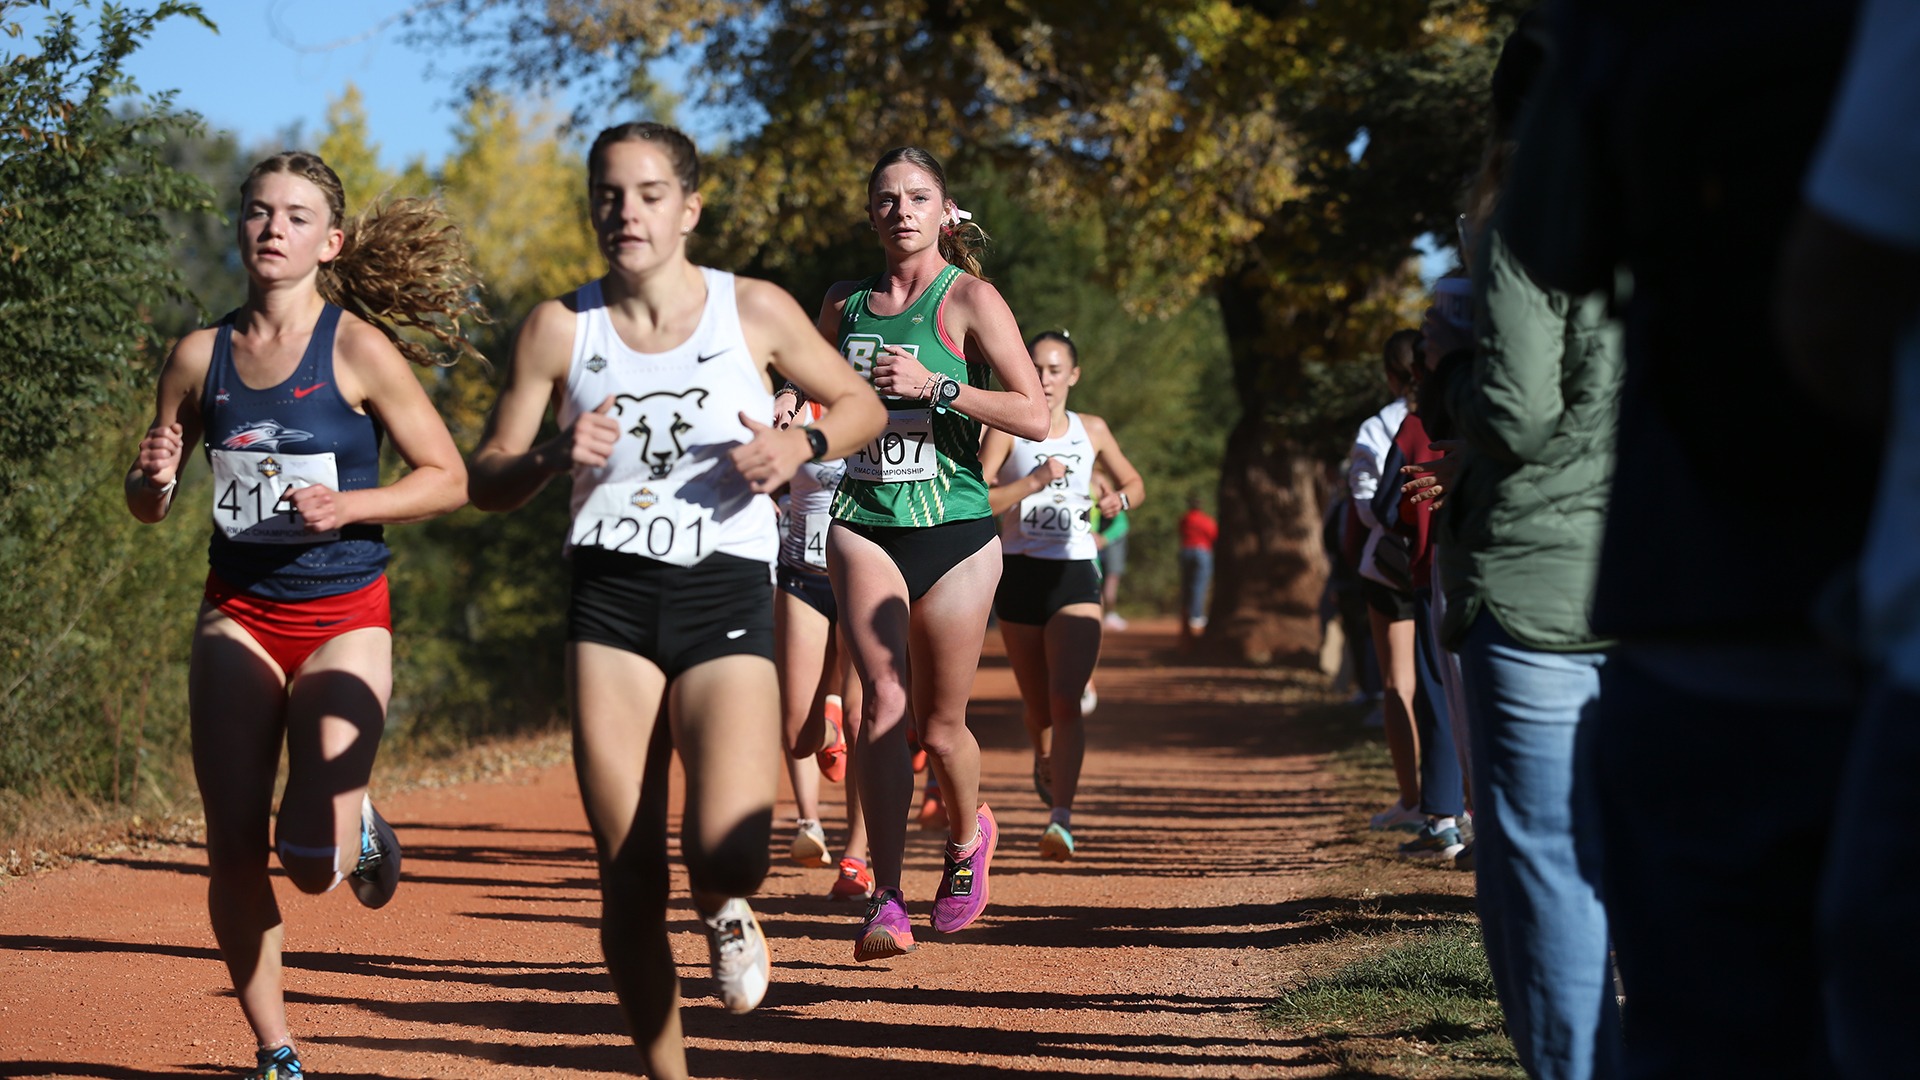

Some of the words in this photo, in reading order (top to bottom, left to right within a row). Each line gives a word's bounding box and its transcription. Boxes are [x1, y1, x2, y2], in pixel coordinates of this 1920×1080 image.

[854, 466, 871, 475] RMAC
[872, 466, 925, 476] CHAMPIONSHIP
[217, 480, 299, 524] 414
[1023, 505, 1087, 532] 4203
[578, 516, 702, 557] 4201
